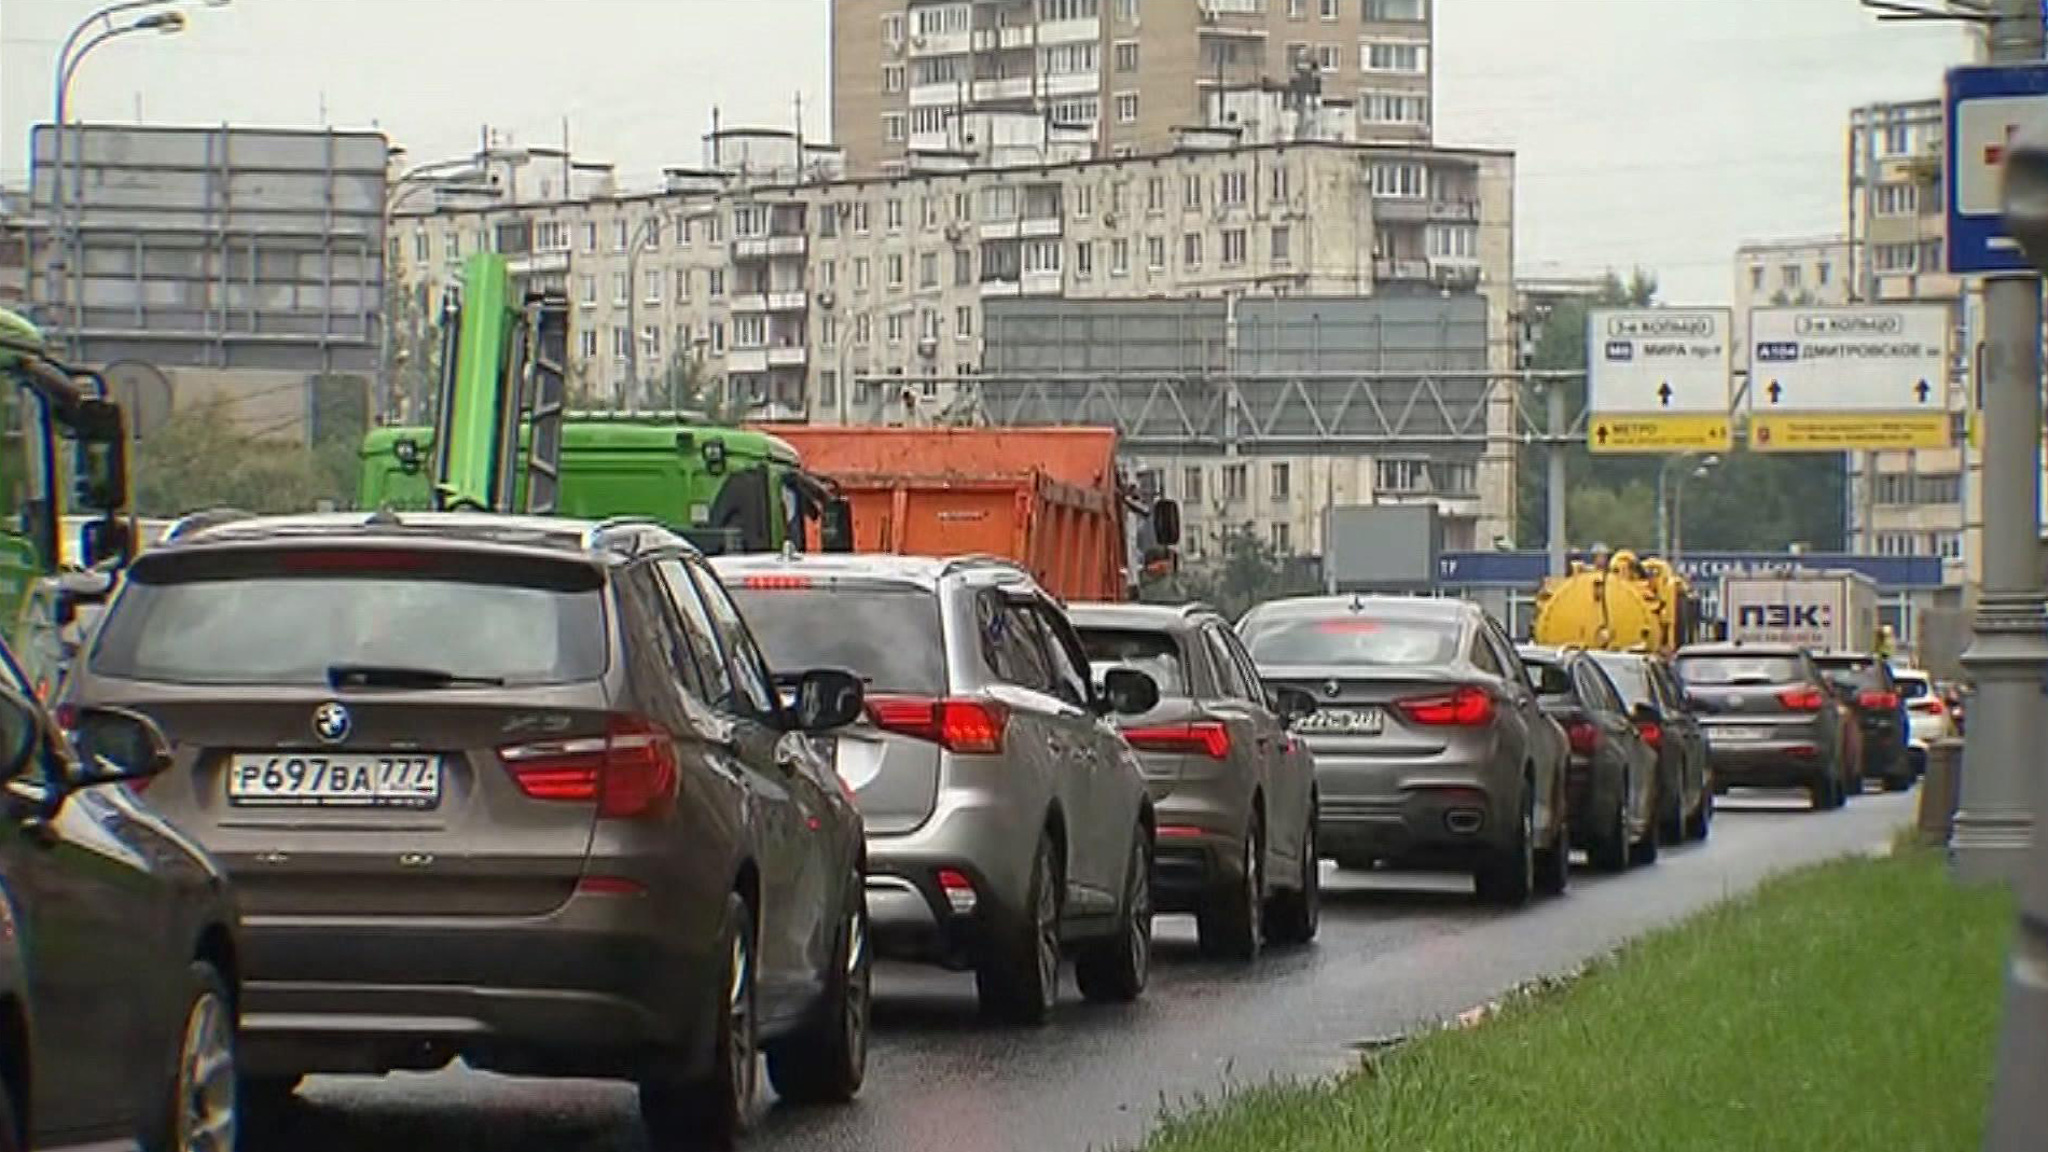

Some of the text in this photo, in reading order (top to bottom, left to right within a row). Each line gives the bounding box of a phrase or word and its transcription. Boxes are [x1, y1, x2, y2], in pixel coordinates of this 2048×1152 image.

[1643, 343, 1686, 356] МИРА
[1803, 343, 1921, 358] ДМИТРОВСКОЕ
[1612, 423, 1658, 435] МЕТРО
[241, 758, 428, 792] Р697ВА 777
